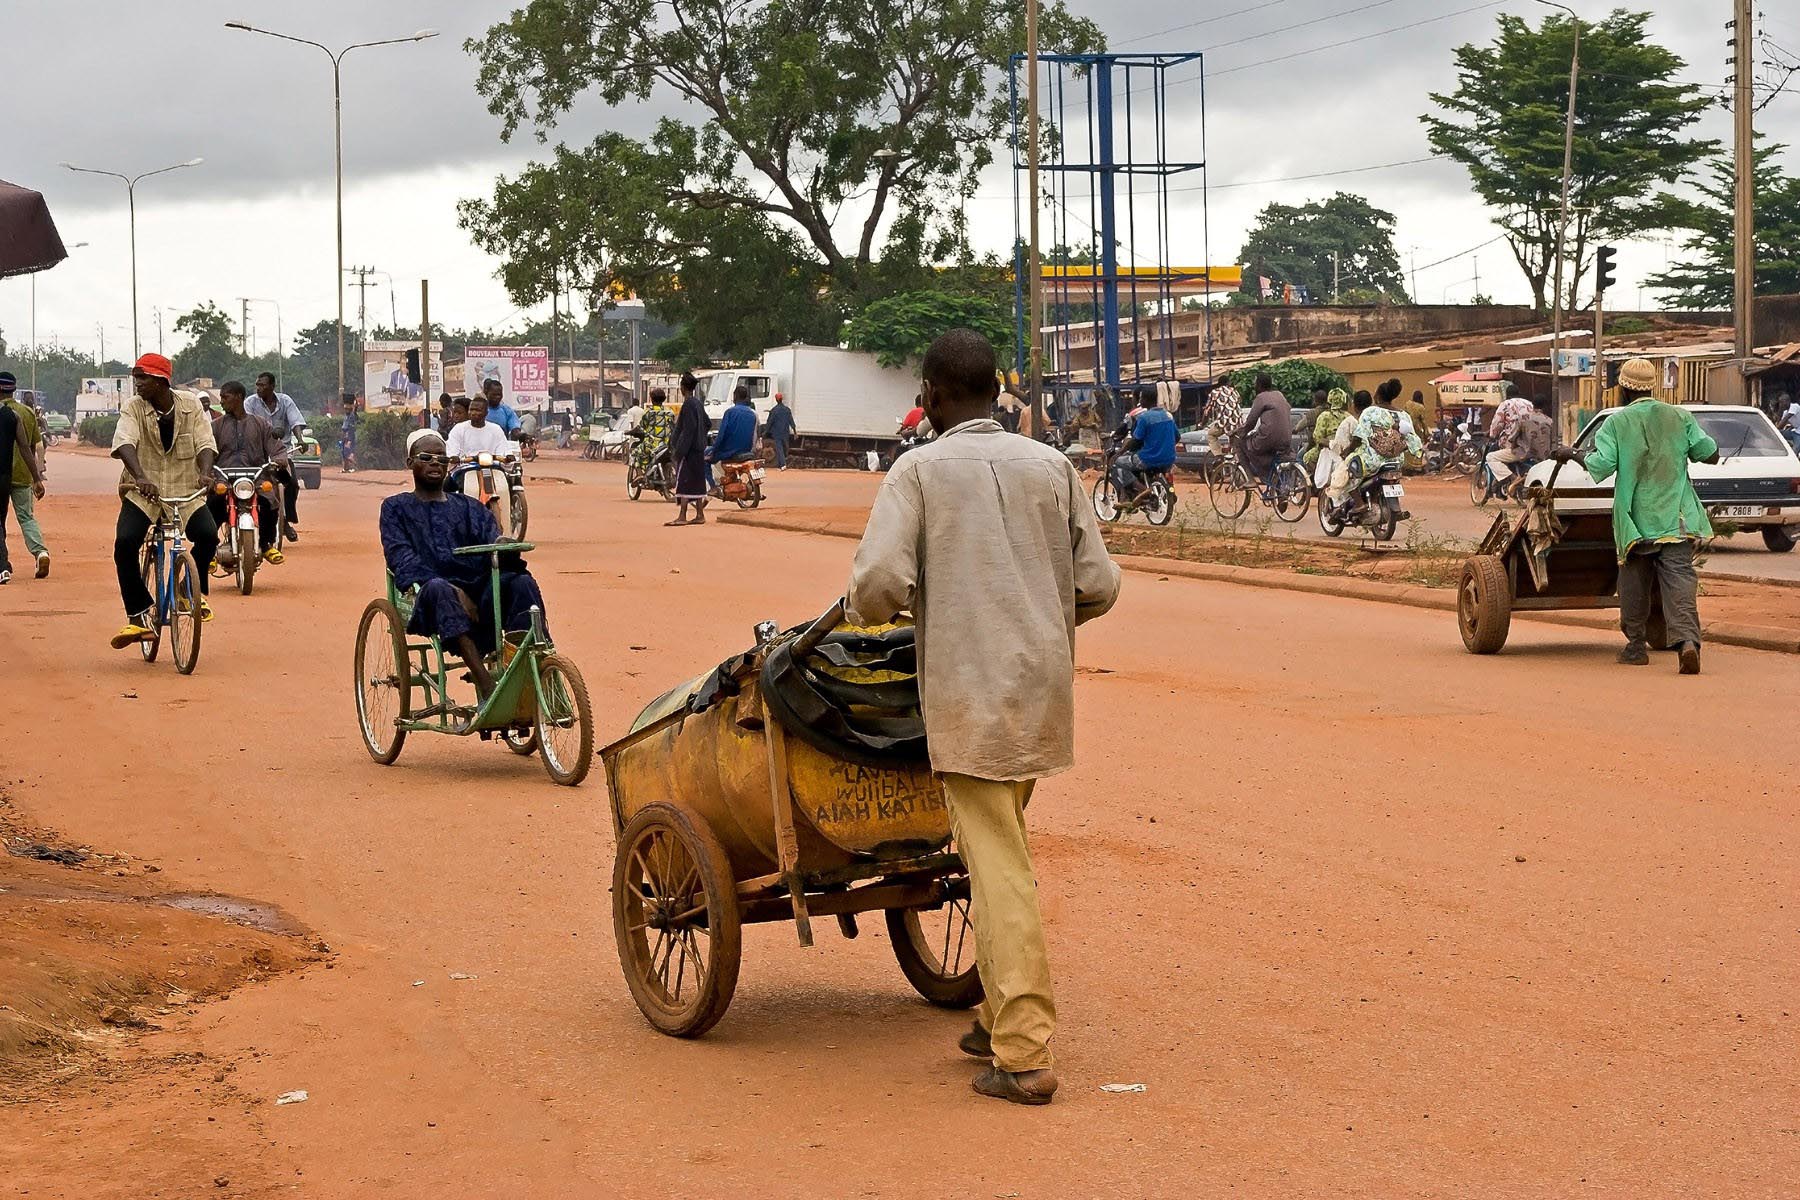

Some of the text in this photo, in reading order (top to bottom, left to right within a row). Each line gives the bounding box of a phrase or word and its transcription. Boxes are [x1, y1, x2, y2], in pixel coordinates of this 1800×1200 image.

[513, 363, 539, 379] 115
[522, 378, 546, 386] minute
[1441, 384, 1459, 393] MAIRIE
[1462, 385, 1489, 393] COMMUNE
